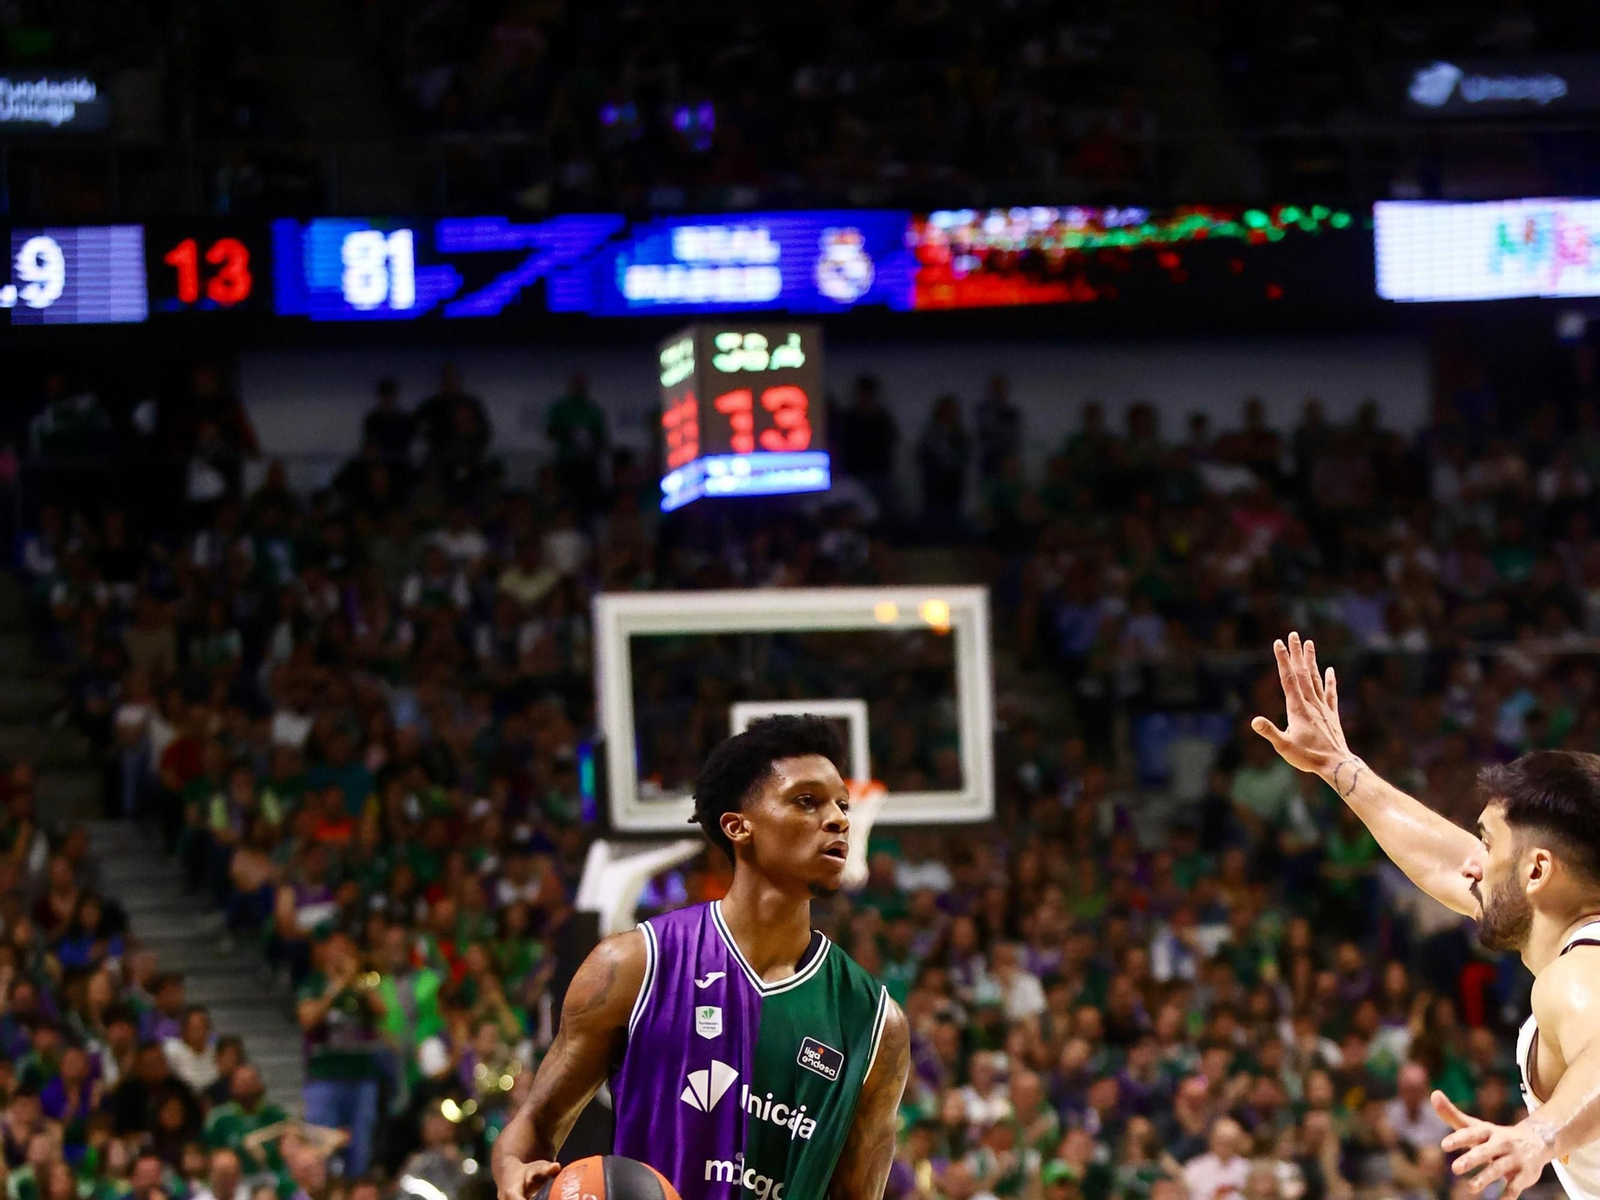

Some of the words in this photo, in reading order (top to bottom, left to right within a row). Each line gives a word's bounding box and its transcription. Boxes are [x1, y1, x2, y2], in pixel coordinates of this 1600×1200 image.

[164, 237, 252, 307] 13
[341, 228, 416, 310] 81
[713, 384, 812, 454] 13
[801, 1055, 836, 1077] endesa
[804, 1046, 821, 1060] liga
